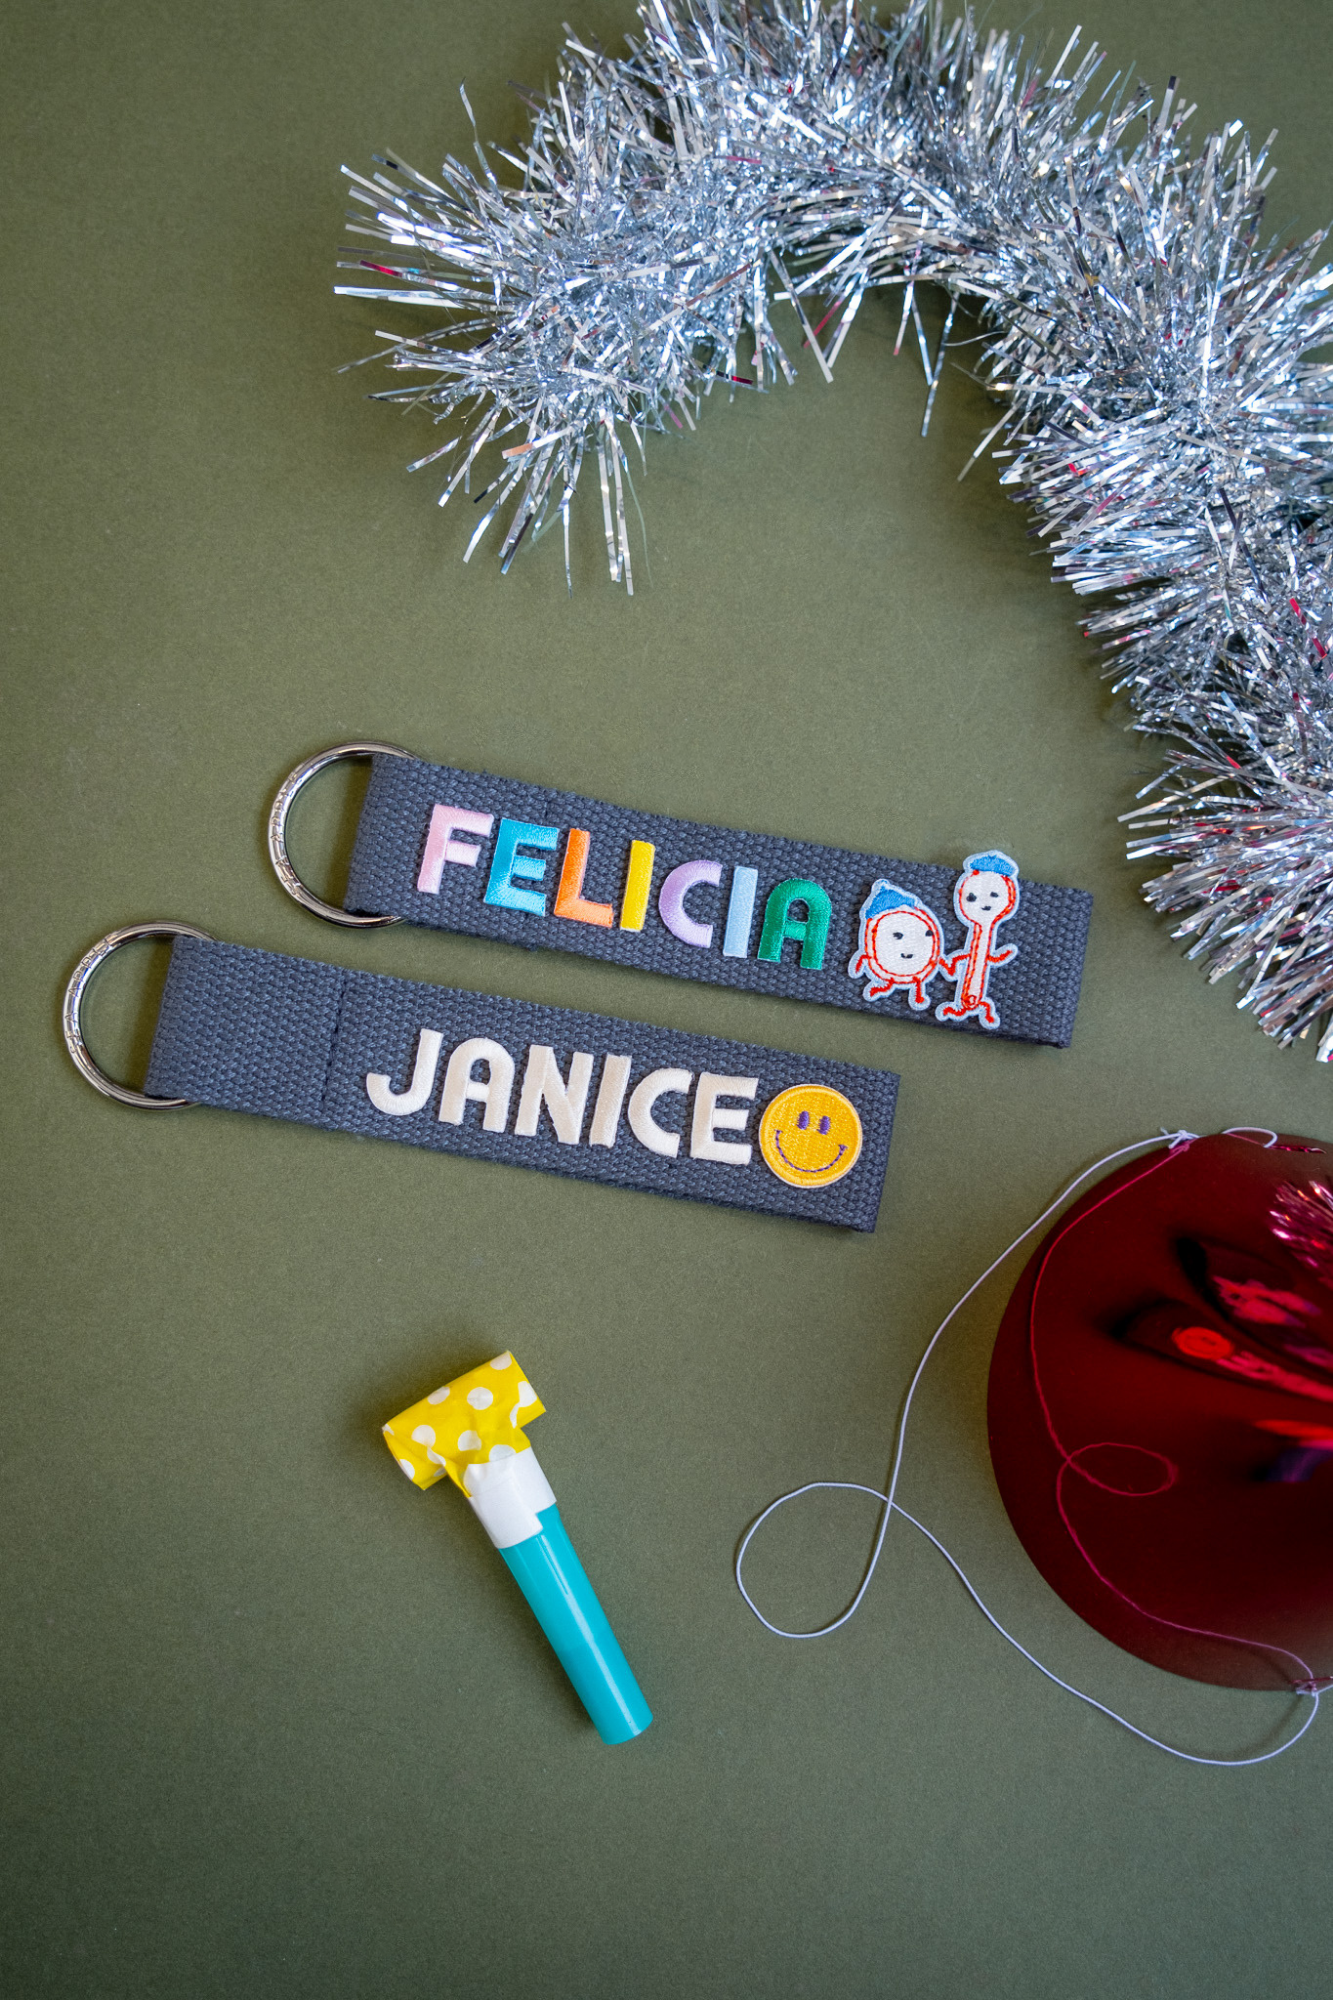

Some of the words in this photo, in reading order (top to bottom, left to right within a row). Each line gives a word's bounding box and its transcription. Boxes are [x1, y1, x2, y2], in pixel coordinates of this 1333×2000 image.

[417, 804, 833, 970] FELICIA
[66, 931, 122, 998] APPLE
[366, 1028, 758, 1166] JANICE
